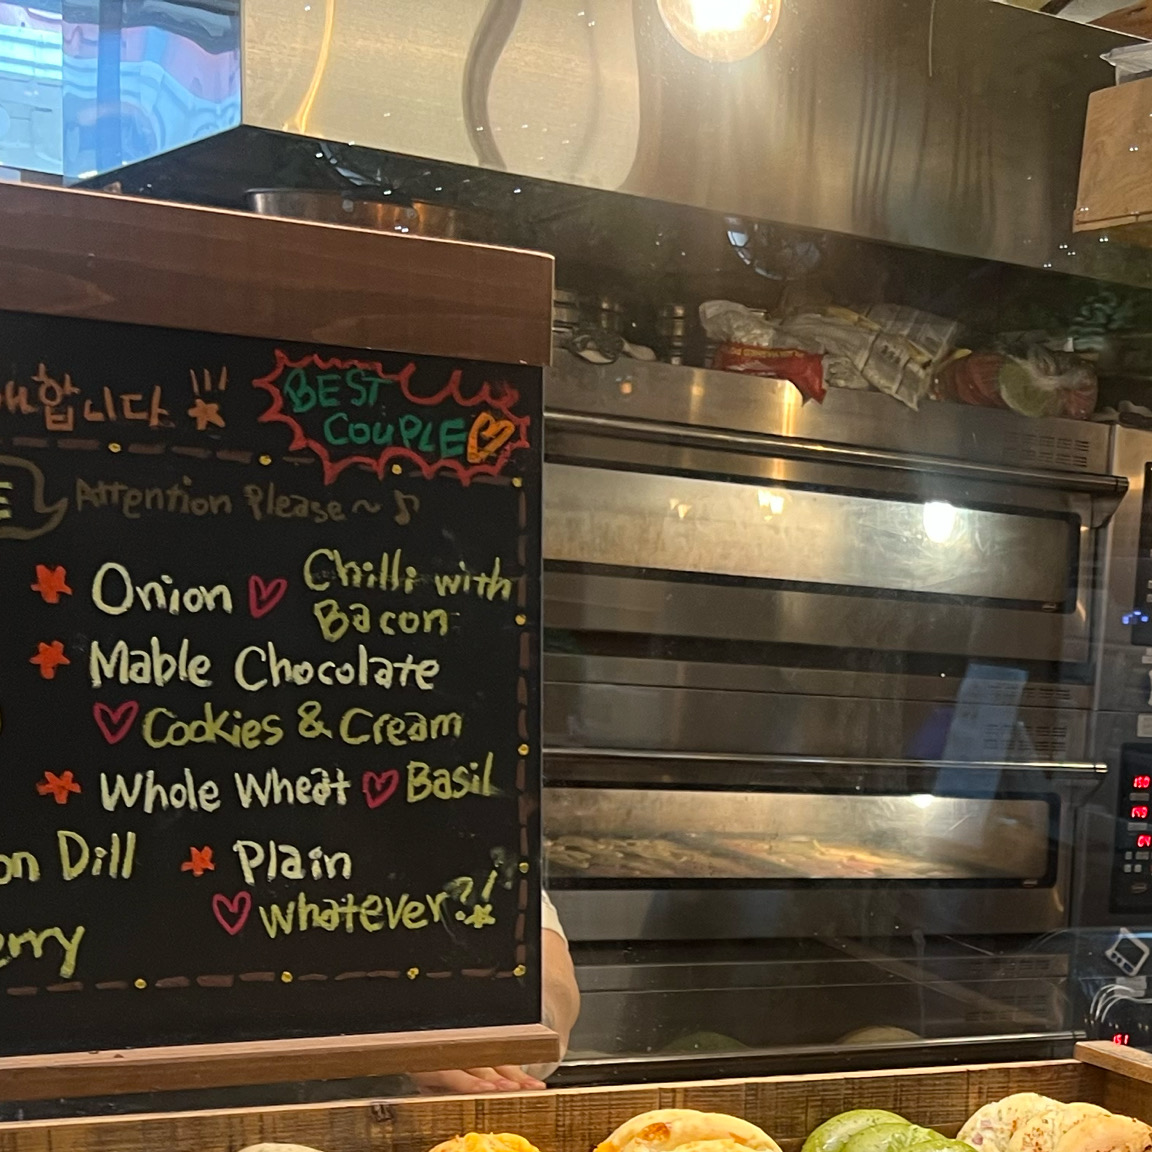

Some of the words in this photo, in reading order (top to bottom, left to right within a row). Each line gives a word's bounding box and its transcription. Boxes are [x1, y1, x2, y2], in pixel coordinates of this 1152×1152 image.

[283, 368, 392, 413] BEST
[76, 476, 232, 519] Attention
[92, 562, 232, 616] Onion
[304, 548, 416, 595] Chilli
[434, 557, 512, 601] with
[314, 599, 449, 642] Bacon
[90, 636, 212, 689] Mable
[234, 640, 440, 692] Chocolate
[142, 703, 283, 748] Cookies
[298, 701, 332, 738] &
[340, 707, 462, 746] Cream
[100, 768, 221, 813] Whole
[235, 768, 351, 810] Wheat
[406, 752, 494, 802] Basil
[57, 830, 137, 881] Dill
[233, 840, 352, 886] Plain
